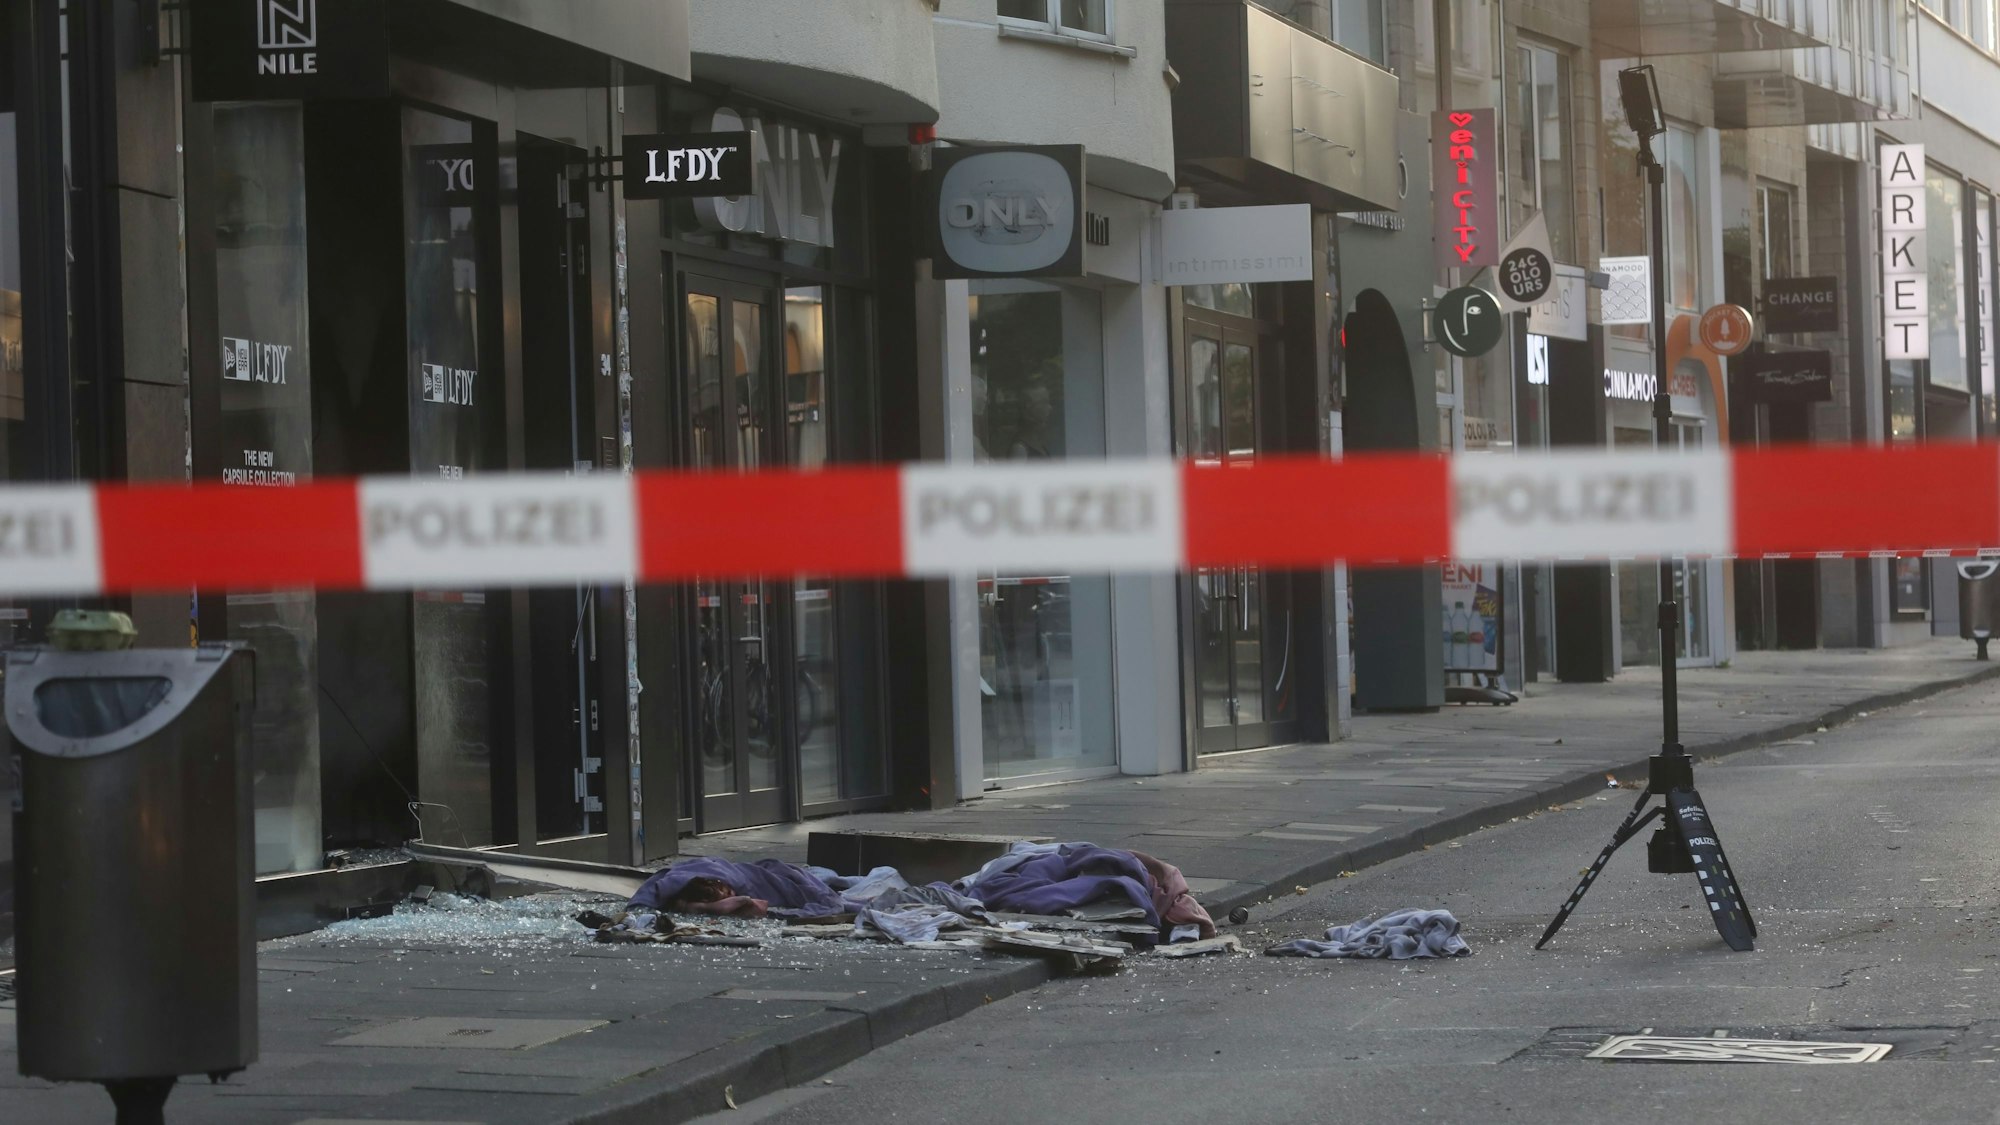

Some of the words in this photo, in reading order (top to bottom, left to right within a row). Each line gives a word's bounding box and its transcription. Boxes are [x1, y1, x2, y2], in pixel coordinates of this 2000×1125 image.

[258, 53, 318, 75] NILE
[947, 196, 1063, 229] ONLY
[1890, 150, 1919, 354] ARKET
[1168, 255, 1304, 273] intimissimi
[1513, 279, 1544, 296] URS
[1768, 291, 1834, 305] CHANGE
[244, 449, 258, 466] THE
[258, 450, 274, 468] NEW
[222, 467, 254, 485] CAPSULE
[1456, 472, 1696, 526] POLIZEI
[918, 483, 1157, 539] POLIZEI
[367, 496, 606, 552] POLIZEI
